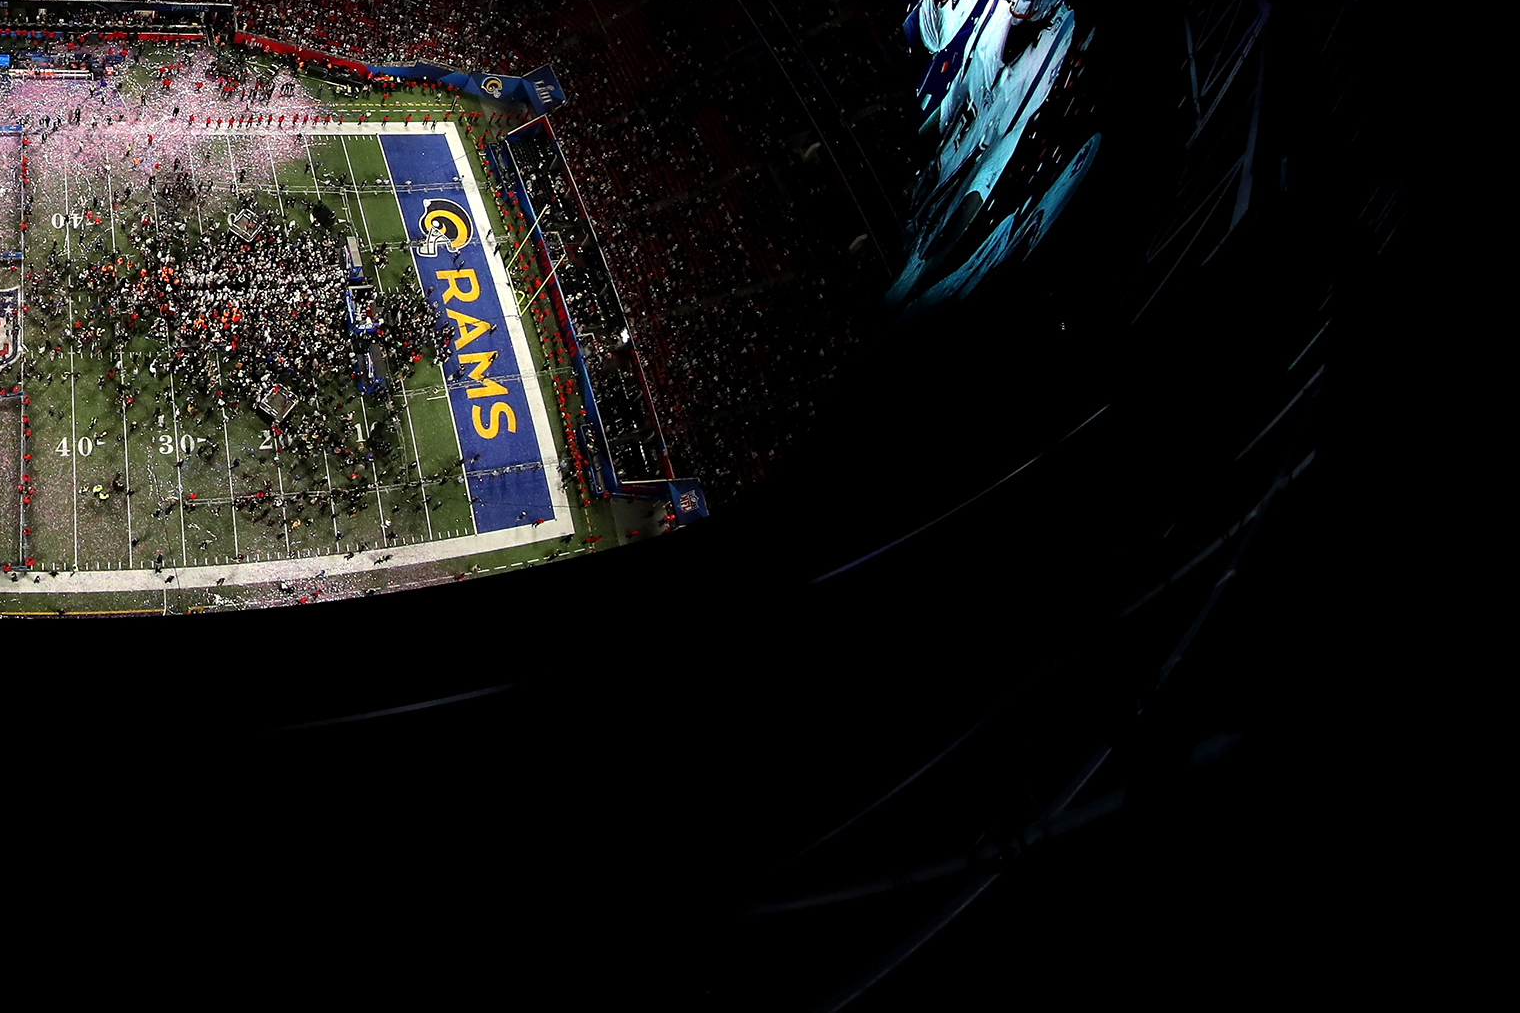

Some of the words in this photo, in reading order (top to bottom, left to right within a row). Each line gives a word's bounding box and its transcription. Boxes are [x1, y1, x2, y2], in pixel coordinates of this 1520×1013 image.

[51, 212, 85, 230] 40
[435, 268, 517, 440] RAMS
[55, 436, 93, 458] 40
[158, 434, 196, 455] 30
